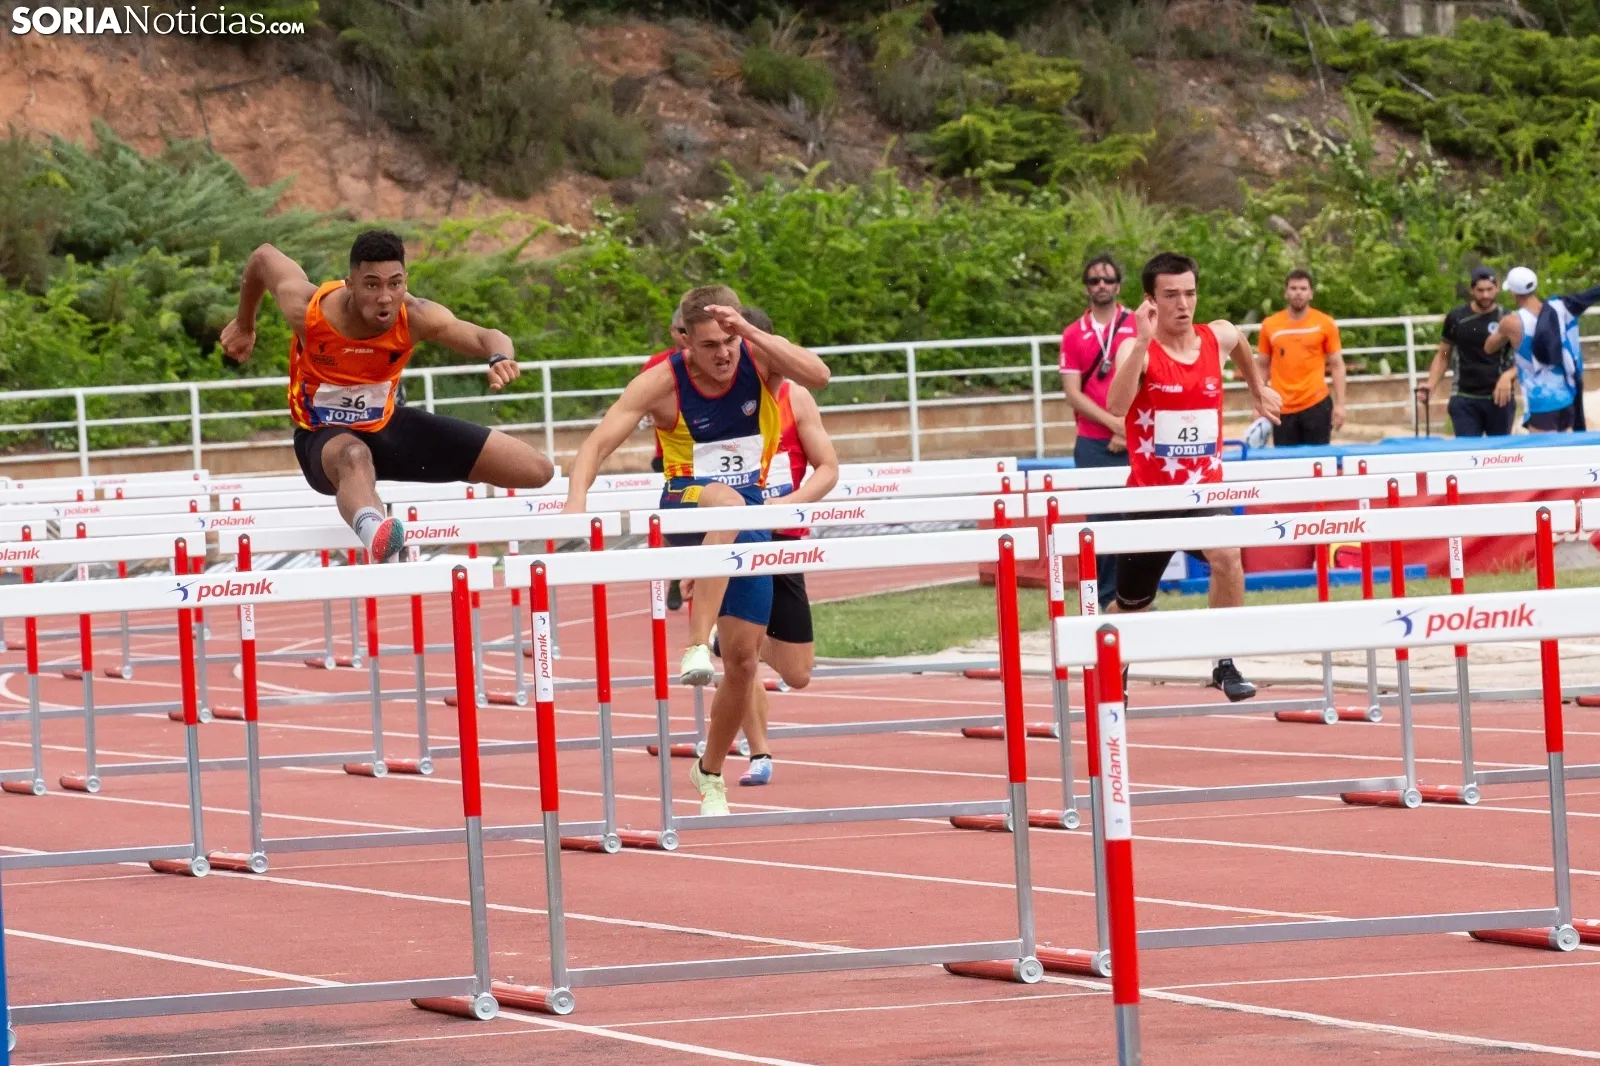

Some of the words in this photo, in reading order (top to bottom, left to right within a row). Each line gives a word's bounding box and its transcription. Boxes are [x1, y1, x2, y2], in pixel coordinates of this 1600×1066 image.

[340, 395, 366, 410] 36
[1177, 427, 1199, 442] 43
[720, 456, 744, 472] 33
[1482, 453, 1524, 466] polanik
[712, 474, 750, 486] oma
[856, 482, 900, 496] polanik
[1206, 486, 1260, 504] polanik
[538, 500, 567, 512] pola
[210, 515, 255, 528] polanik
[811, 506, 865, 523] polanik
[404, 525, 460, 542] polanik
[1293, 517, 1367, 540] polanik
[0, 547, 40, 560] lanik
[751, 546, 825, 570] polanik
[196, 578, 274, 602] polanik
[1425, 603, 1535, 638] polanik
[538, 633, 550, 678] polanik
[1106, 736, 1126, 804] polanik
